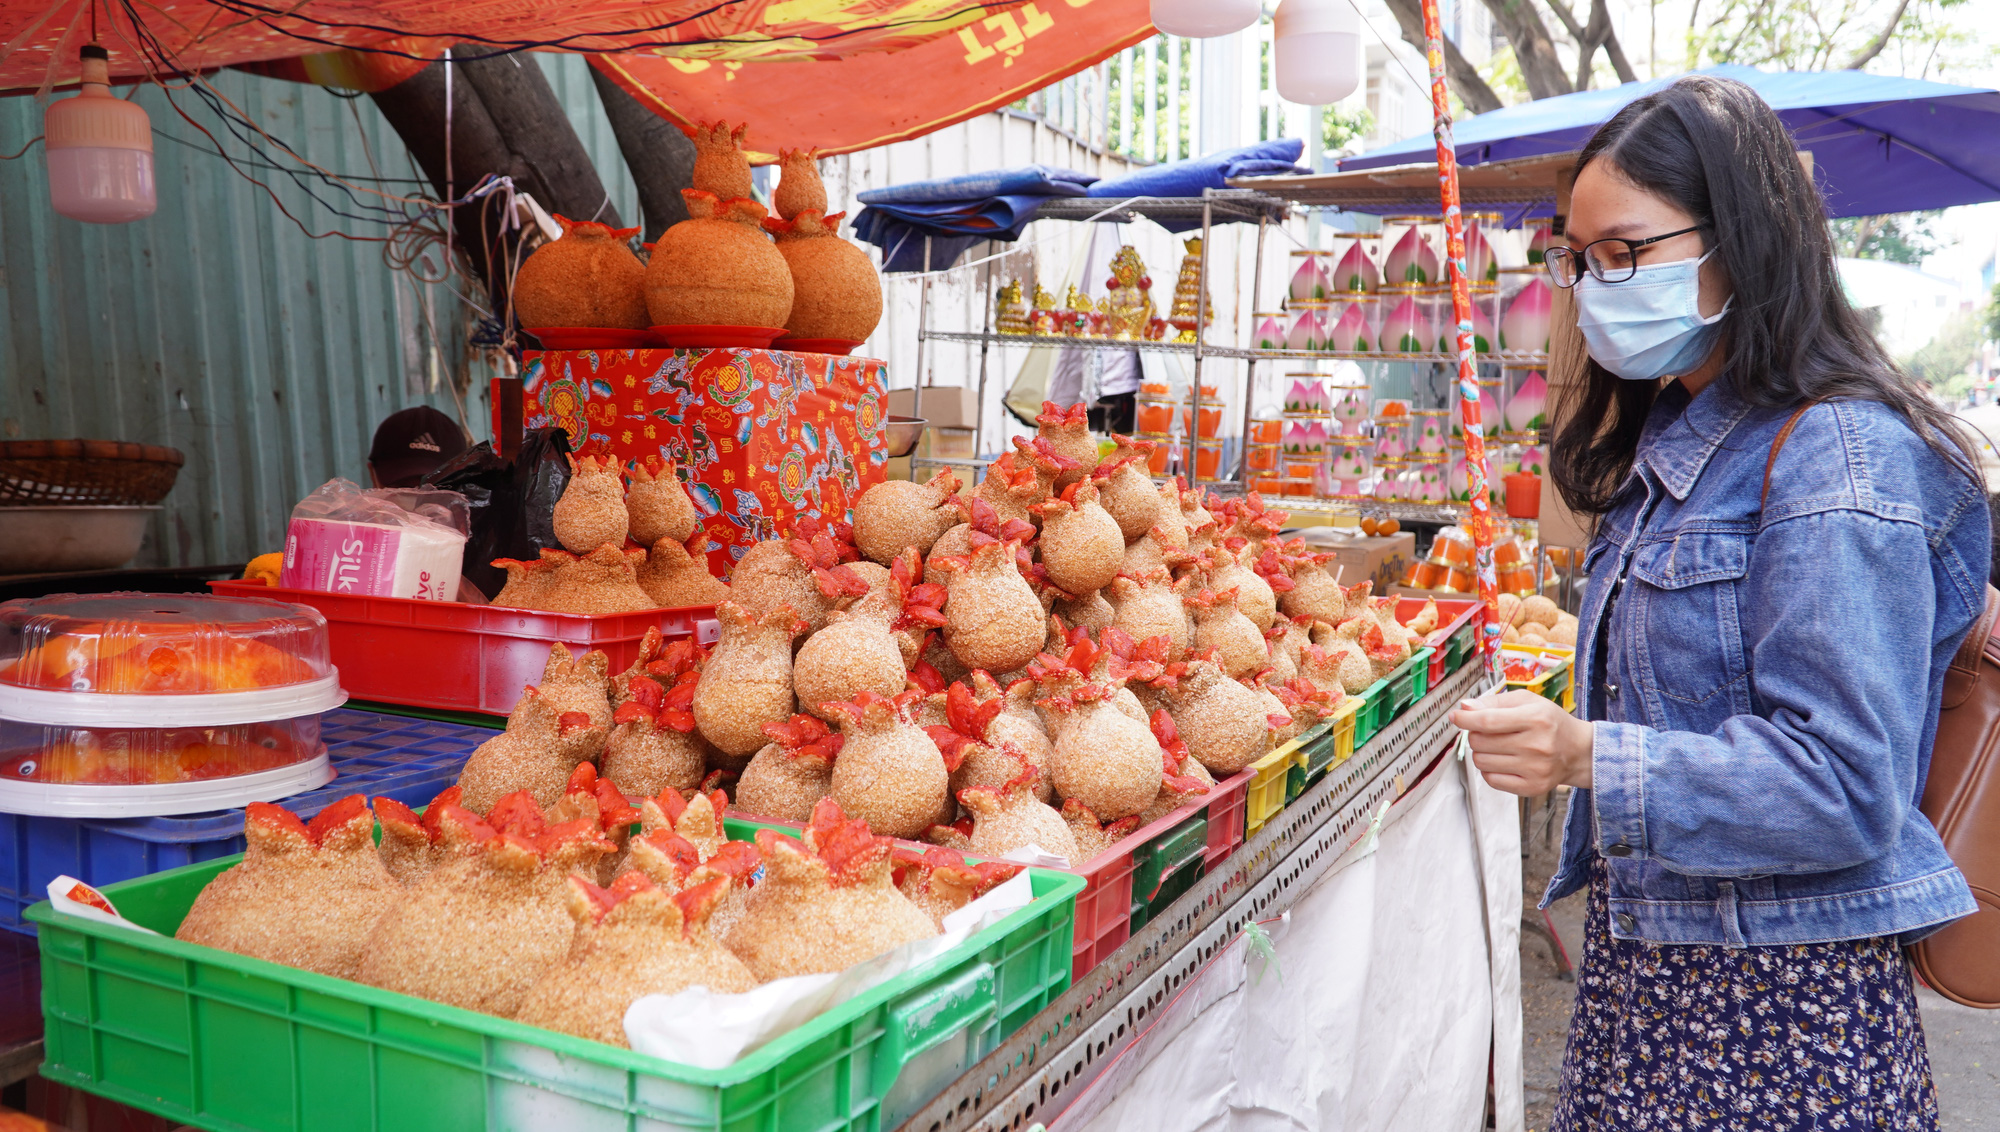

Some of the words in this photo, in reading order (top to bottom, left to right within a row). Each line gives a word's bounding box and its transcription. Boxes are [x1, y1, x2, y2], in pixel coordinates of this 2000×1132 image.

[957, 2, 1054, 68] TẾT
[409, 442, 441, 452] adidas
[337, 538, 364, 591] Silk
